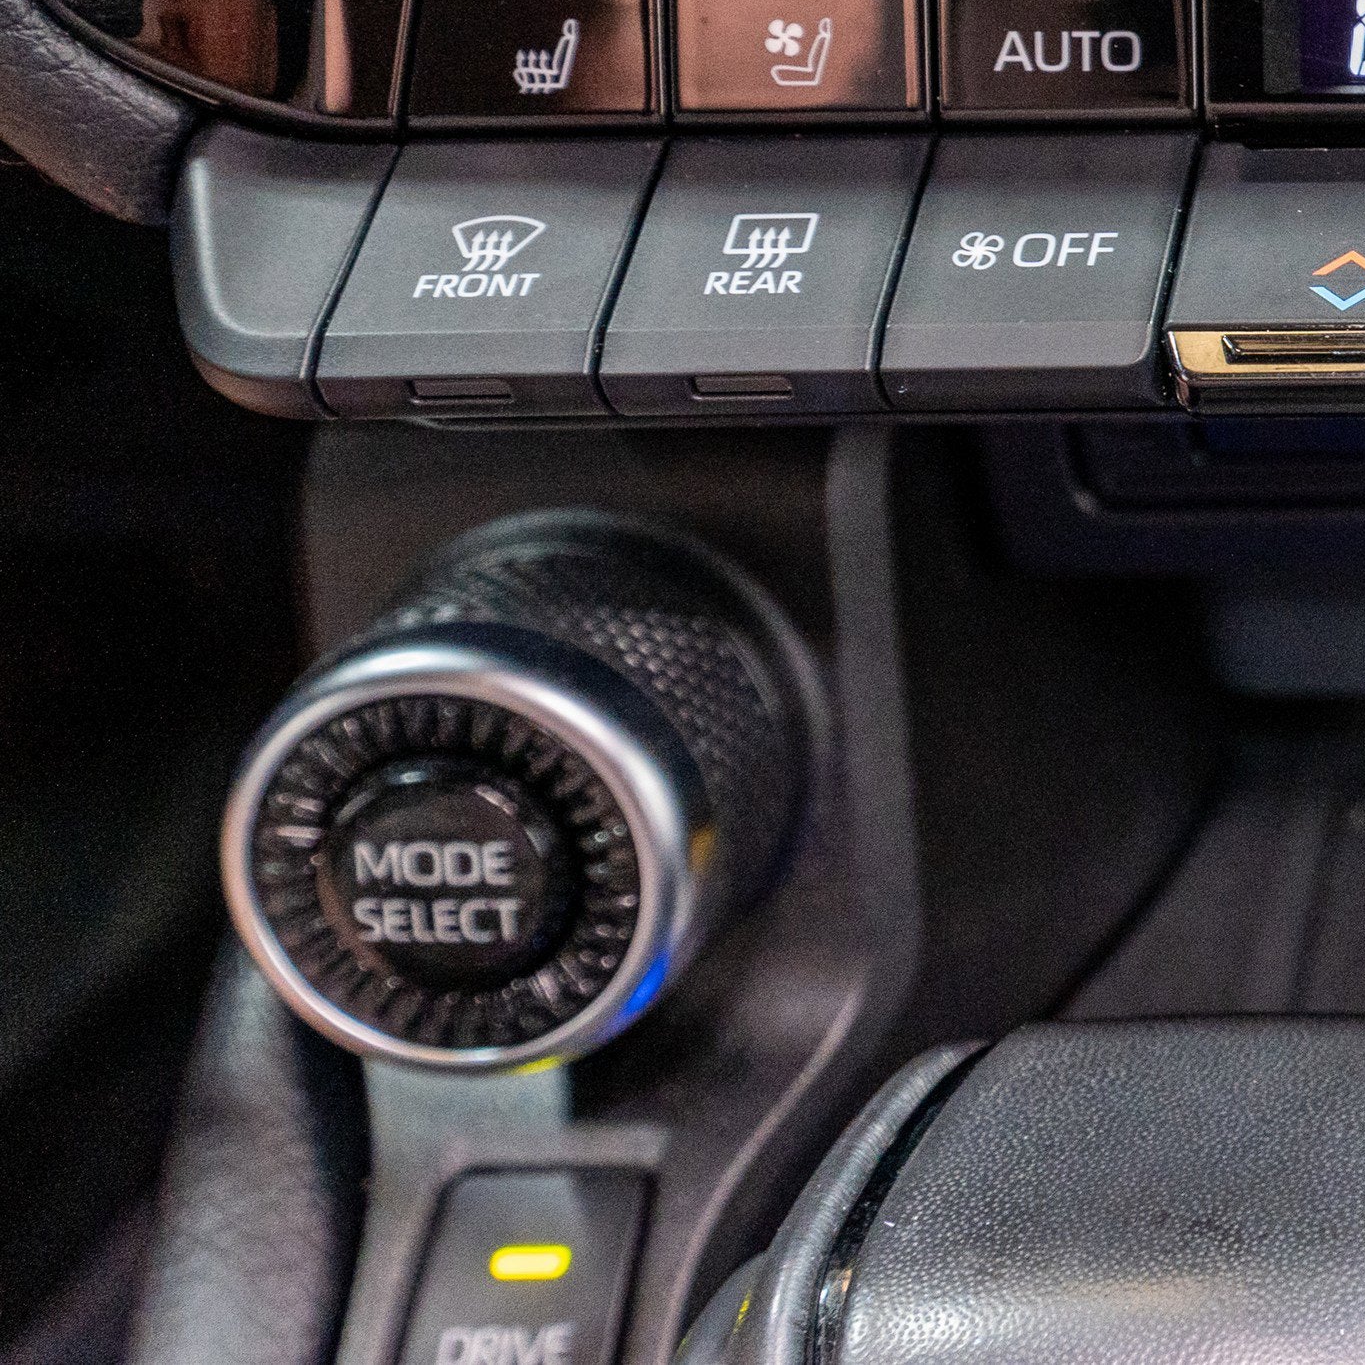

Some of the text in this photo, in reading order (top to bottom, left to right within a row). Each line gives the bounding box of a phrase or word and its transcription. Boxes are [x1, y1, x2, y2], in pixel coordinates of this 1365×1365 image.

[992, 29, 1142, 74] AUTO
[1011, 231, 1119, 269] OFF
[411, 272, 541, 299] FRONT
[702, 269, 804, 296] REAR
[353, 839, 514, 888] MODE
[351, 897, 521, 944] SELECT
[435, 1324, 574, 1365] DRIVE
